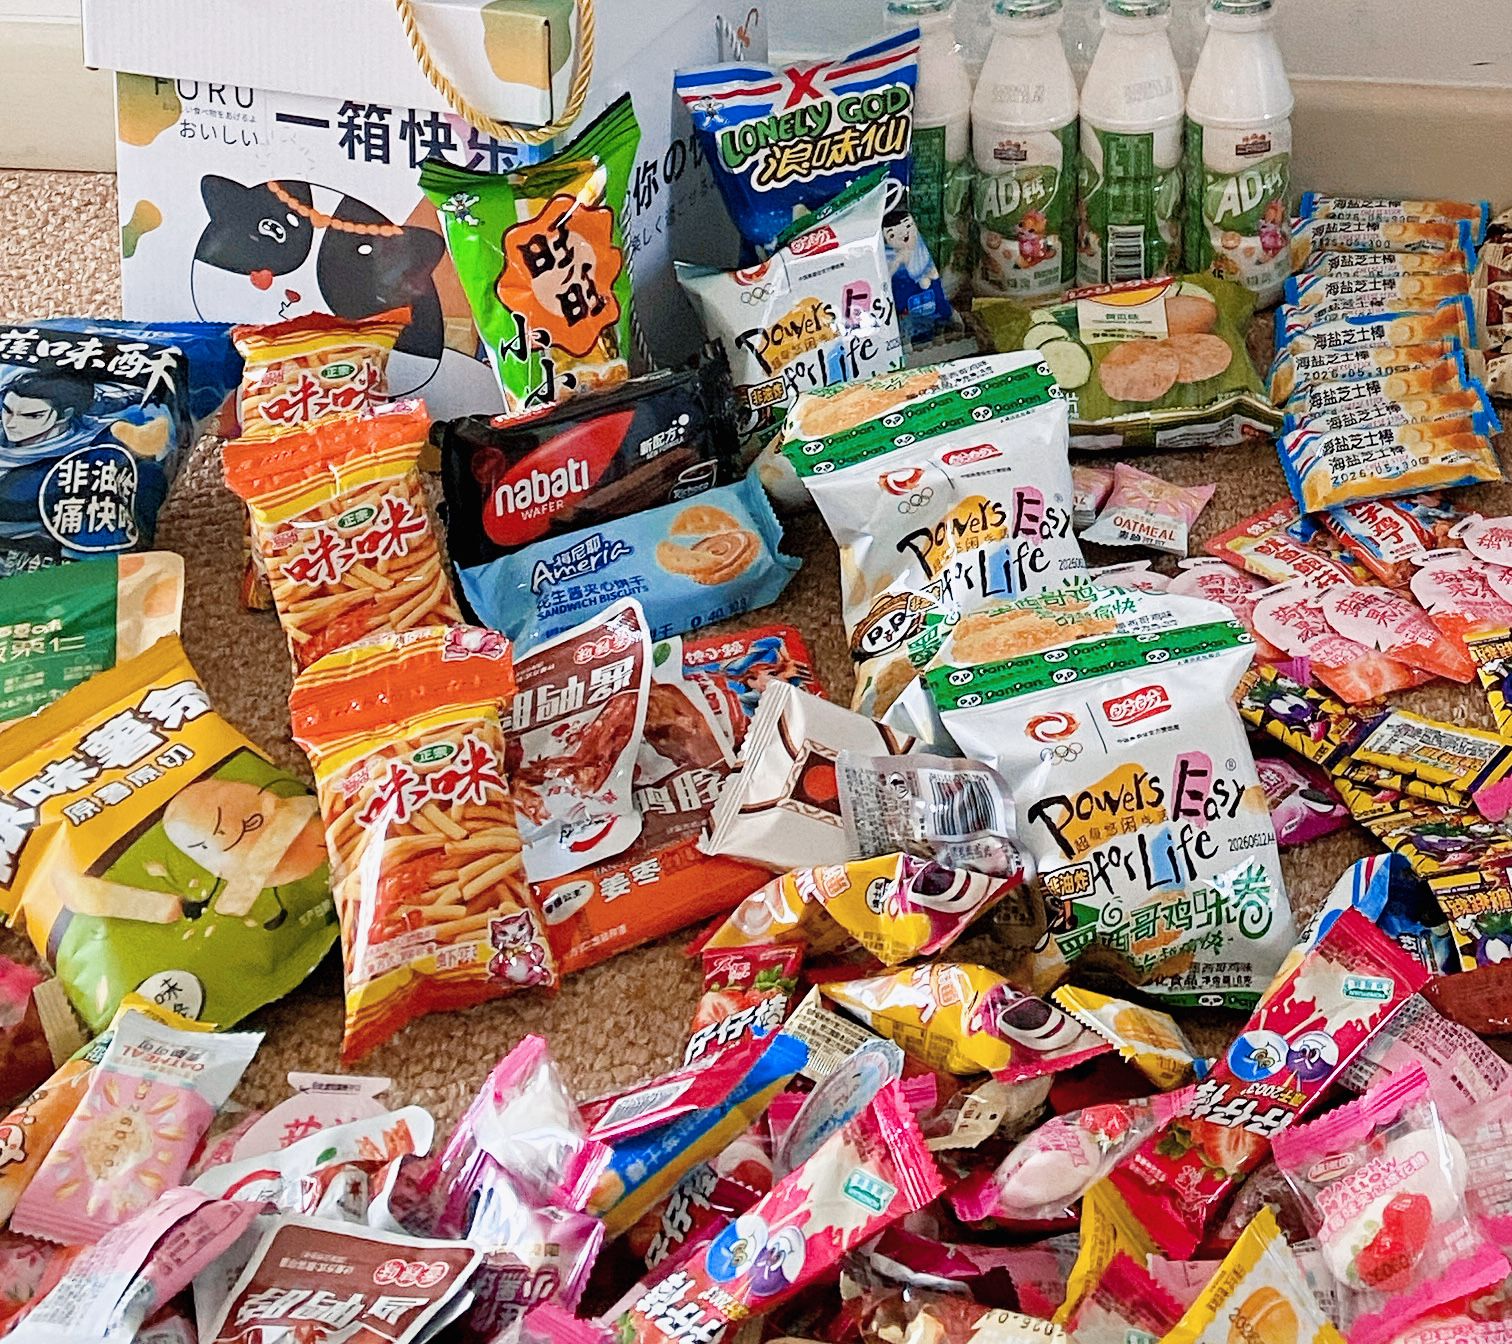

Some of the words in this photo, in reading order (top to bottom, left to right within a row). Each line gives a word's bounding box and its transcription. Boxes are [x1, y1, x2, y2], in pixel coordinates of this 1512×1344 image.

[180, 119, 259, 147] おいしい
[721, 101, 831, 167] LONELY
[840, 85, 910, 124] GOD
[757, 115, 906, 185] 浪味仙
[1325, 278, 1397, 296] 海盐芝士棒
[818, 336, 879, 386] Life
[1312, 324, 1385, 350] 海盐芝士棒
[495, 457, 590, 517] nabati
[520, 498, 565, 521] WAFER
[1012, 491, 1071, 539] Easy
[1113, 515, 1176, 542] OATMEAL
[282, 497, 428, 584] 咪咪
[979, 541, 1051, 597] Life
[537, 597, 597, 622] SANDWICH
[600, 585, 649, 604] BISCUITS
[357, 736, 507, 827] 咪咪
[1028, 772, 1165, 860] Powers
[1171, 759, 1246, 822] Easy
[1094, 846, 1137, 895] for
[1138, 823, 1220, 892] Life
[122, 1045, 205, 1072] OATMEAL
